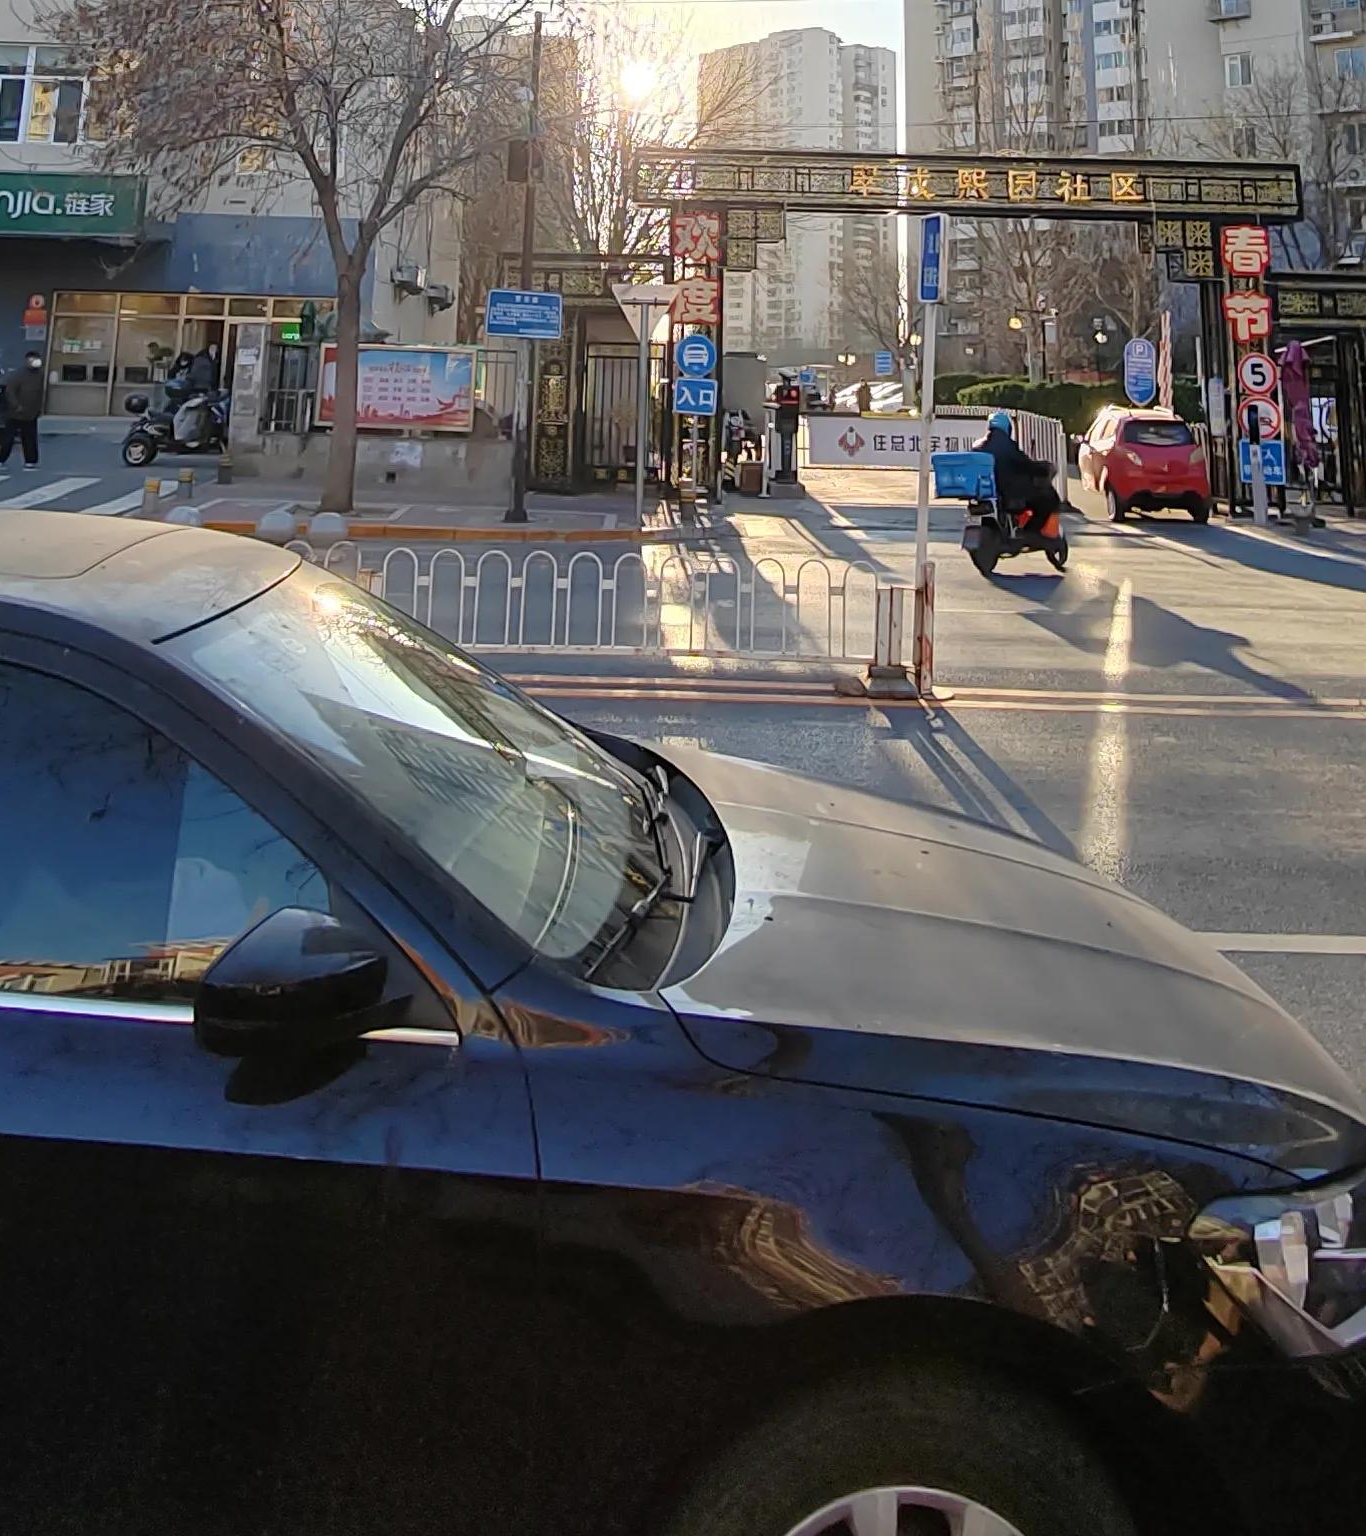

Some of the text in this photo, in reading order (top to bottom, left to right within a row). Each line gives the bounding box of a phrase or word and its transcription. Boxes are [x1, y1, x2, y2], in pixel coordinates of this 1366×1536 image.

[672, 213, 720, 324] 欢度
[1223, 225, 1271, 343] 春节
[677, 386, 714, 407] 入口
[1250, 363, 1267, 386] 5
